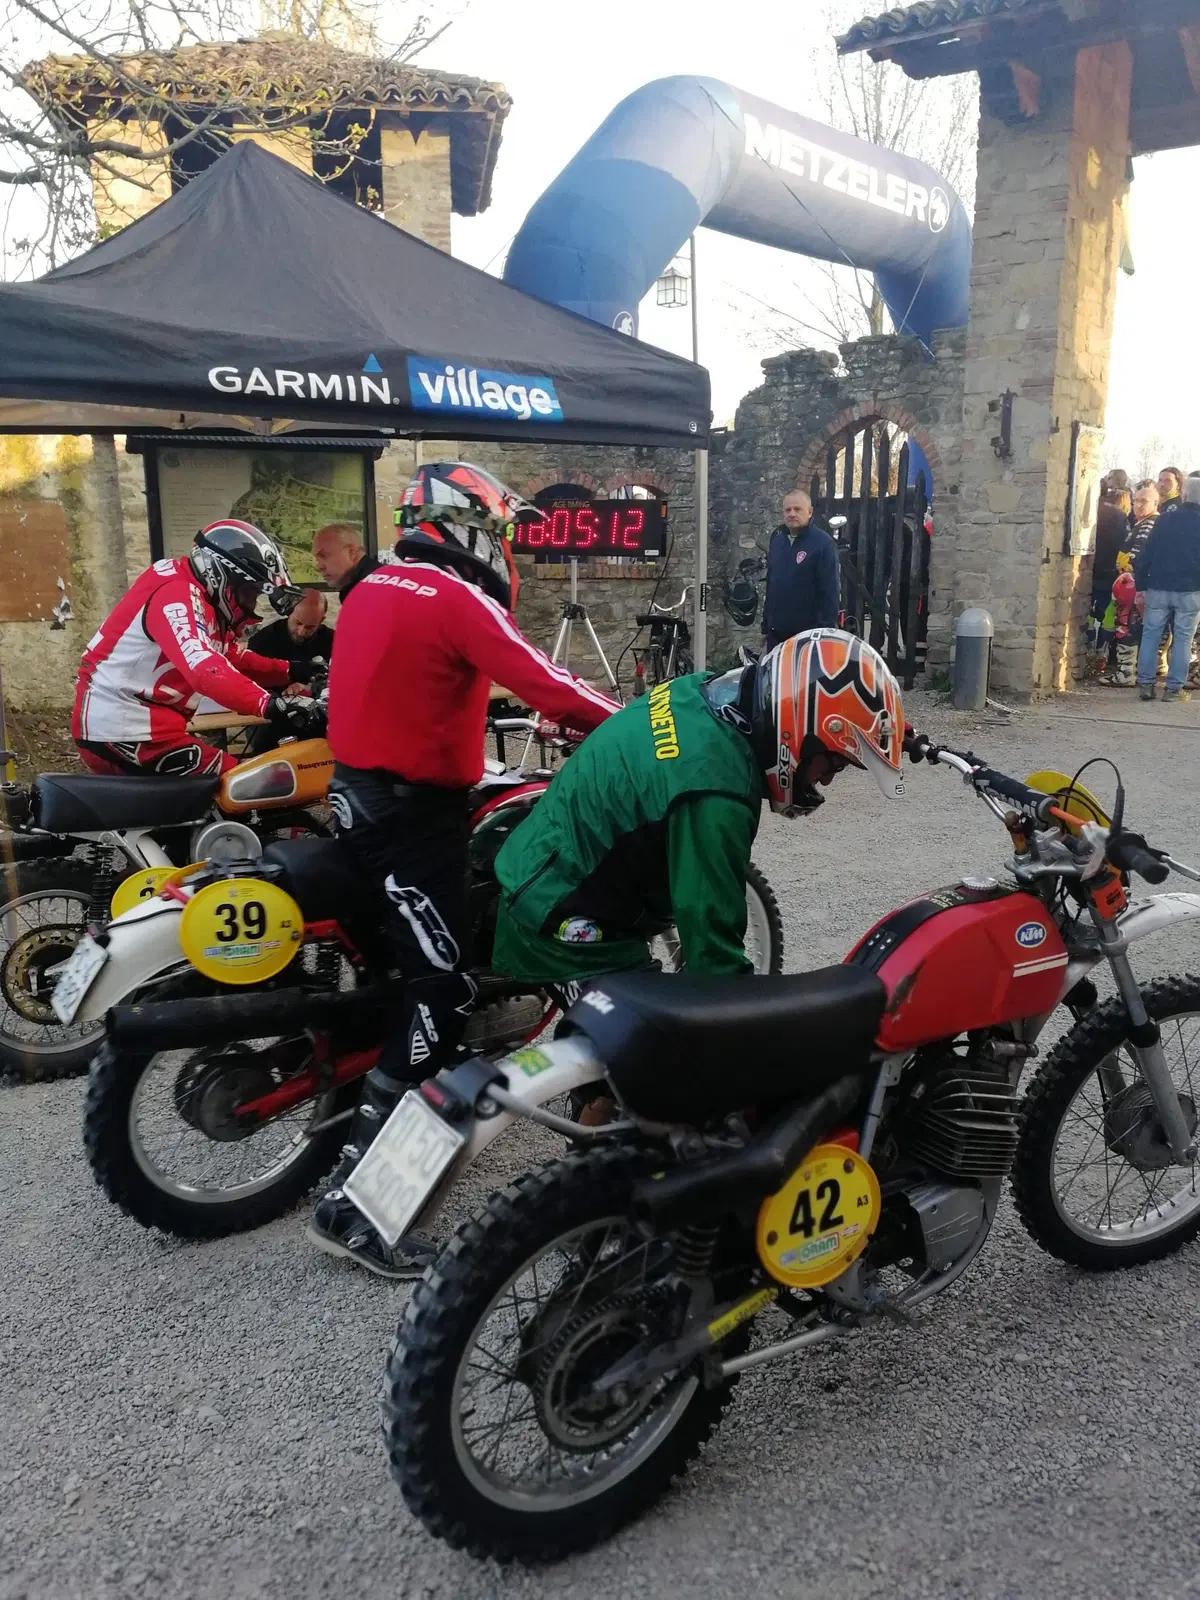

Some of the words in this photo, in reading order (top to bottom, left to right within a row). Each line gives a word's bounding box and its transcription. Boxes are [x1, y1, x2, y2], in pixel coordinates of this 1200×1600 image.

[744, 113, 929, 222] METZELER
[208, 366, 391, 405] GARMIN
[418, 365, 553, 420] village
[202, 546, 257, 582] SCOTT
[163, 602, 214, 671] GILERA
[214, 901, 266, 942] 39
[1020, 927, 1044, 942] KTM
[789, 1178, 844, 1239] 42
[857, 1194, 869, 1208] A3
